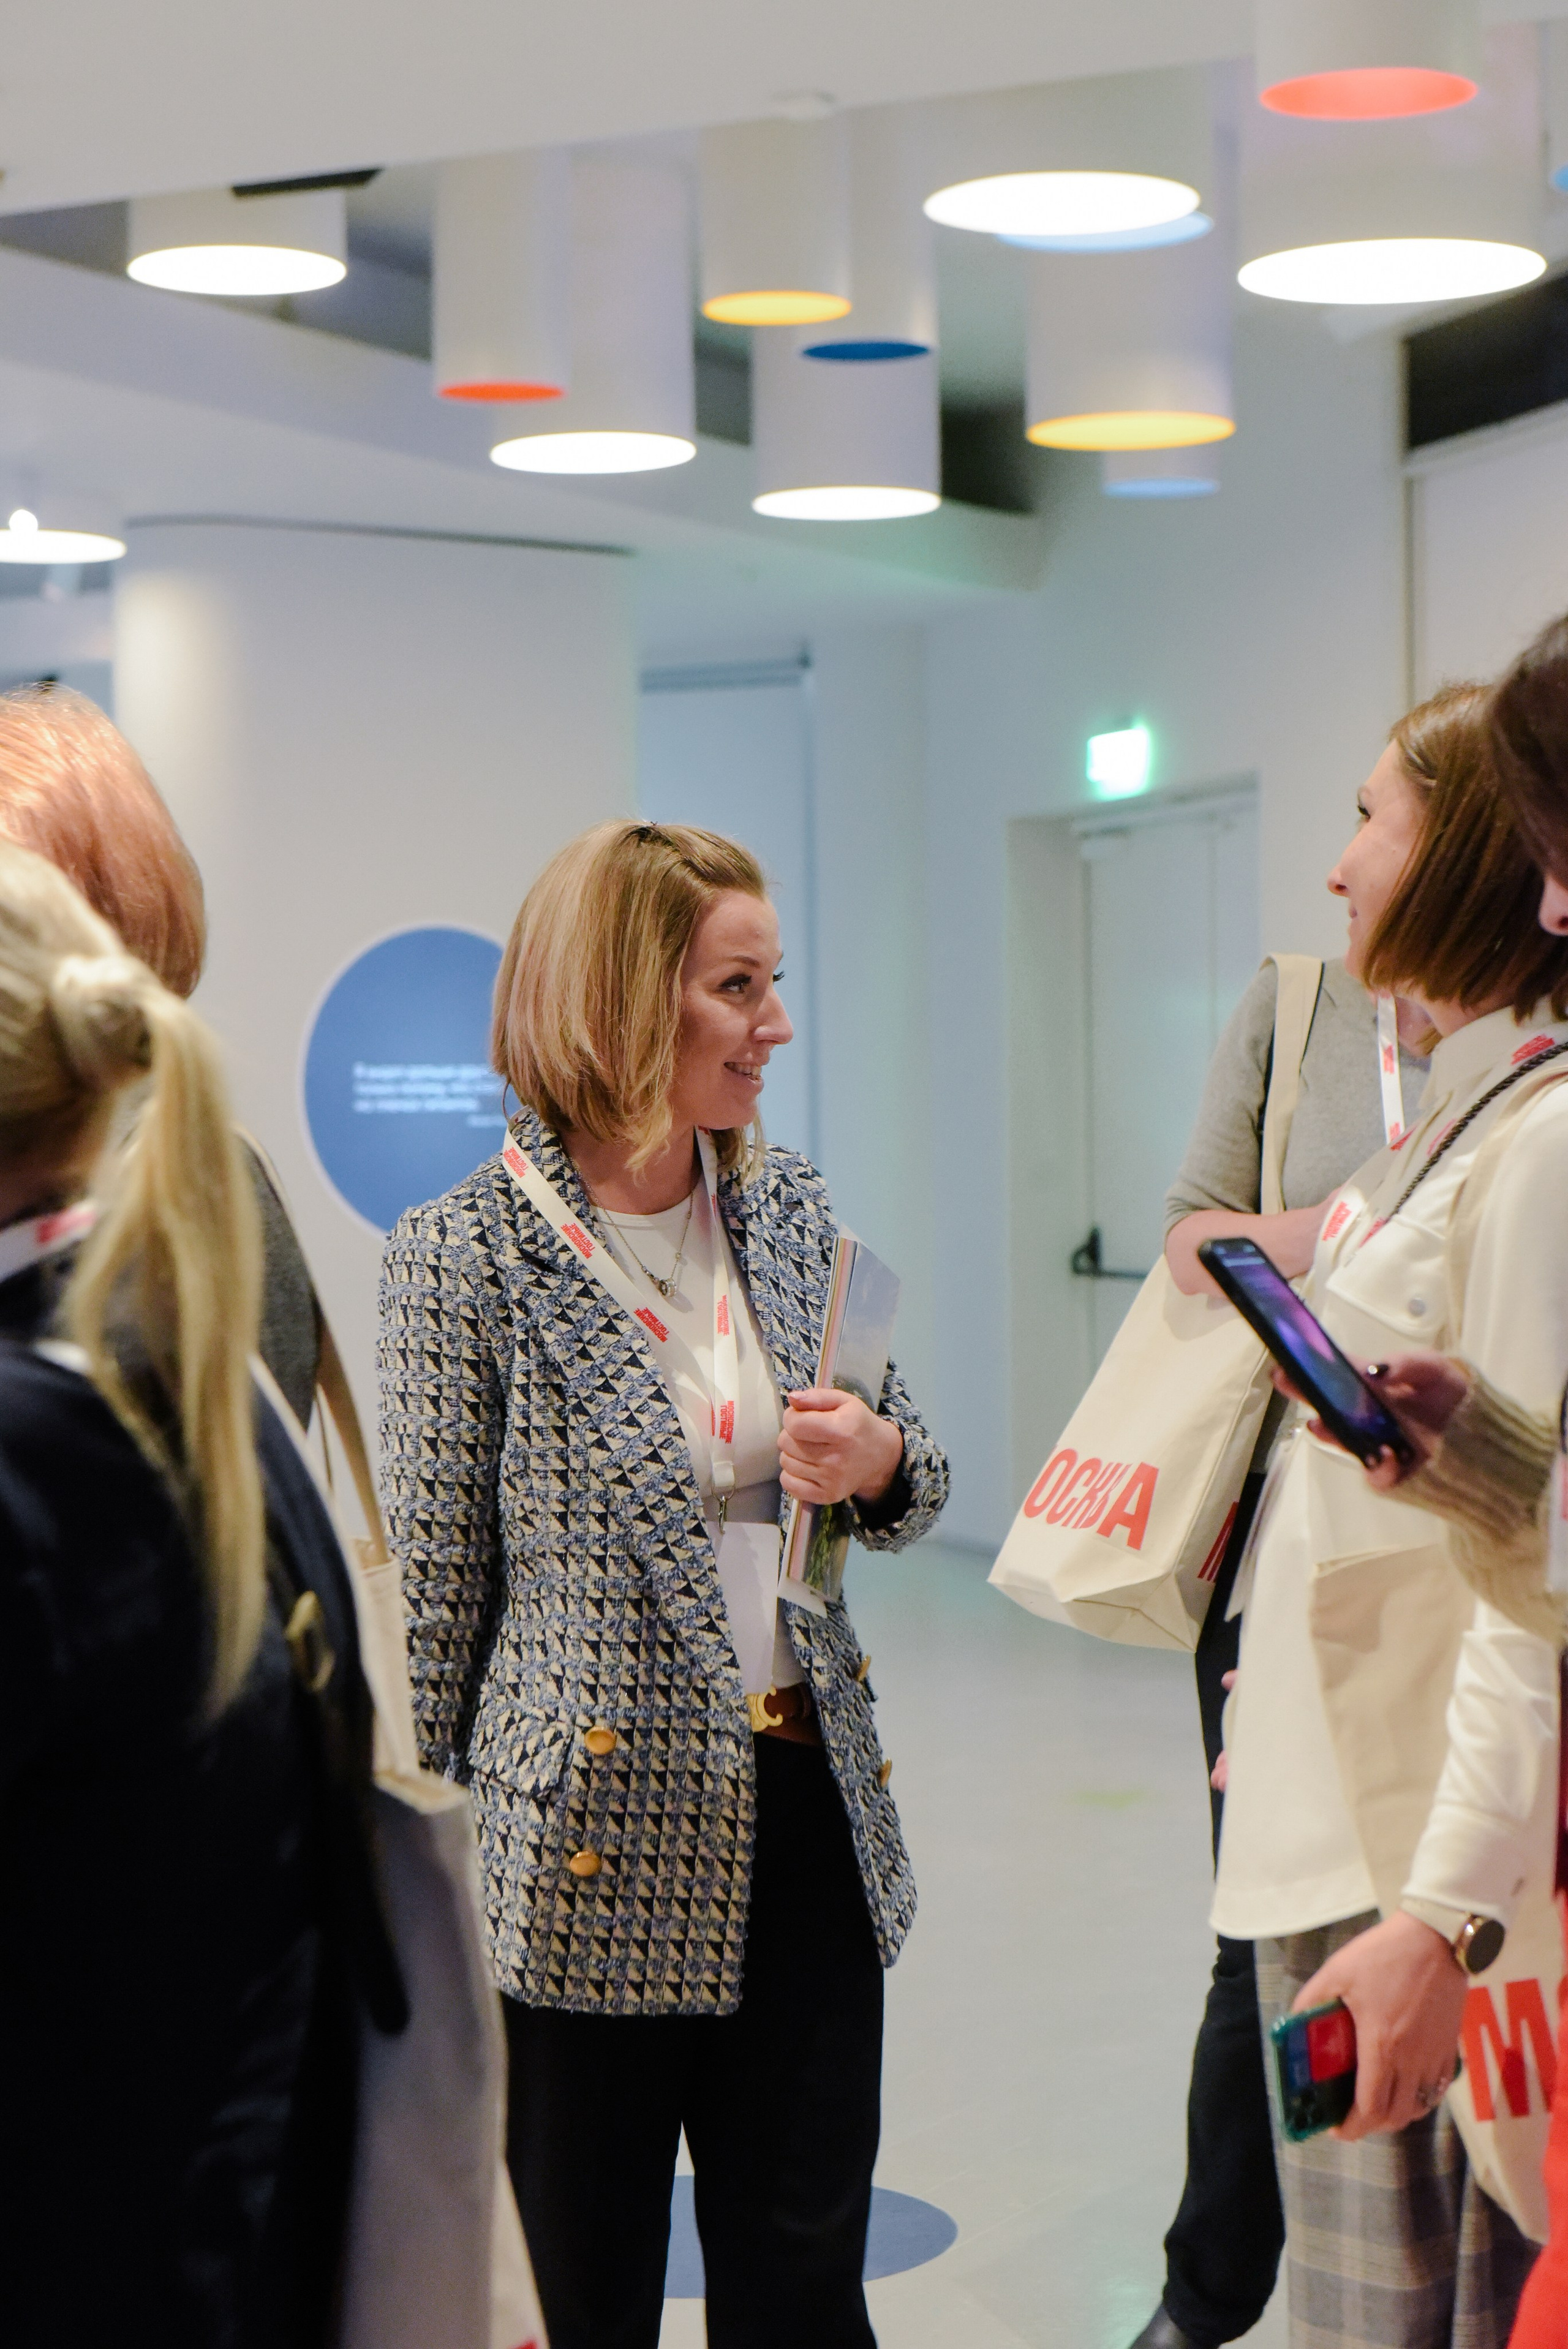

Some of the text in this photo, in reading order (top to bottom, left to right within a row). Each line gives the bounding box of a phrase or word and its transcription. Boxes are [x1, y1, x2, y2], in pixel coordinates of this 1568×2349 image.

[559, 1223, 592, 1259] МОСКОВСКИЕ
[568, 1222, 595, 1251] ГОСТИНЫЕ
[633, 1307, 668, 1343] МОСКОВСКИЕ
[641, 1306, 669, 1335] ГОСТИНЫЕ
[1024, 1446, 1159, 1550] ОСКВА
[1460, 1976, 1567, 2123] М
